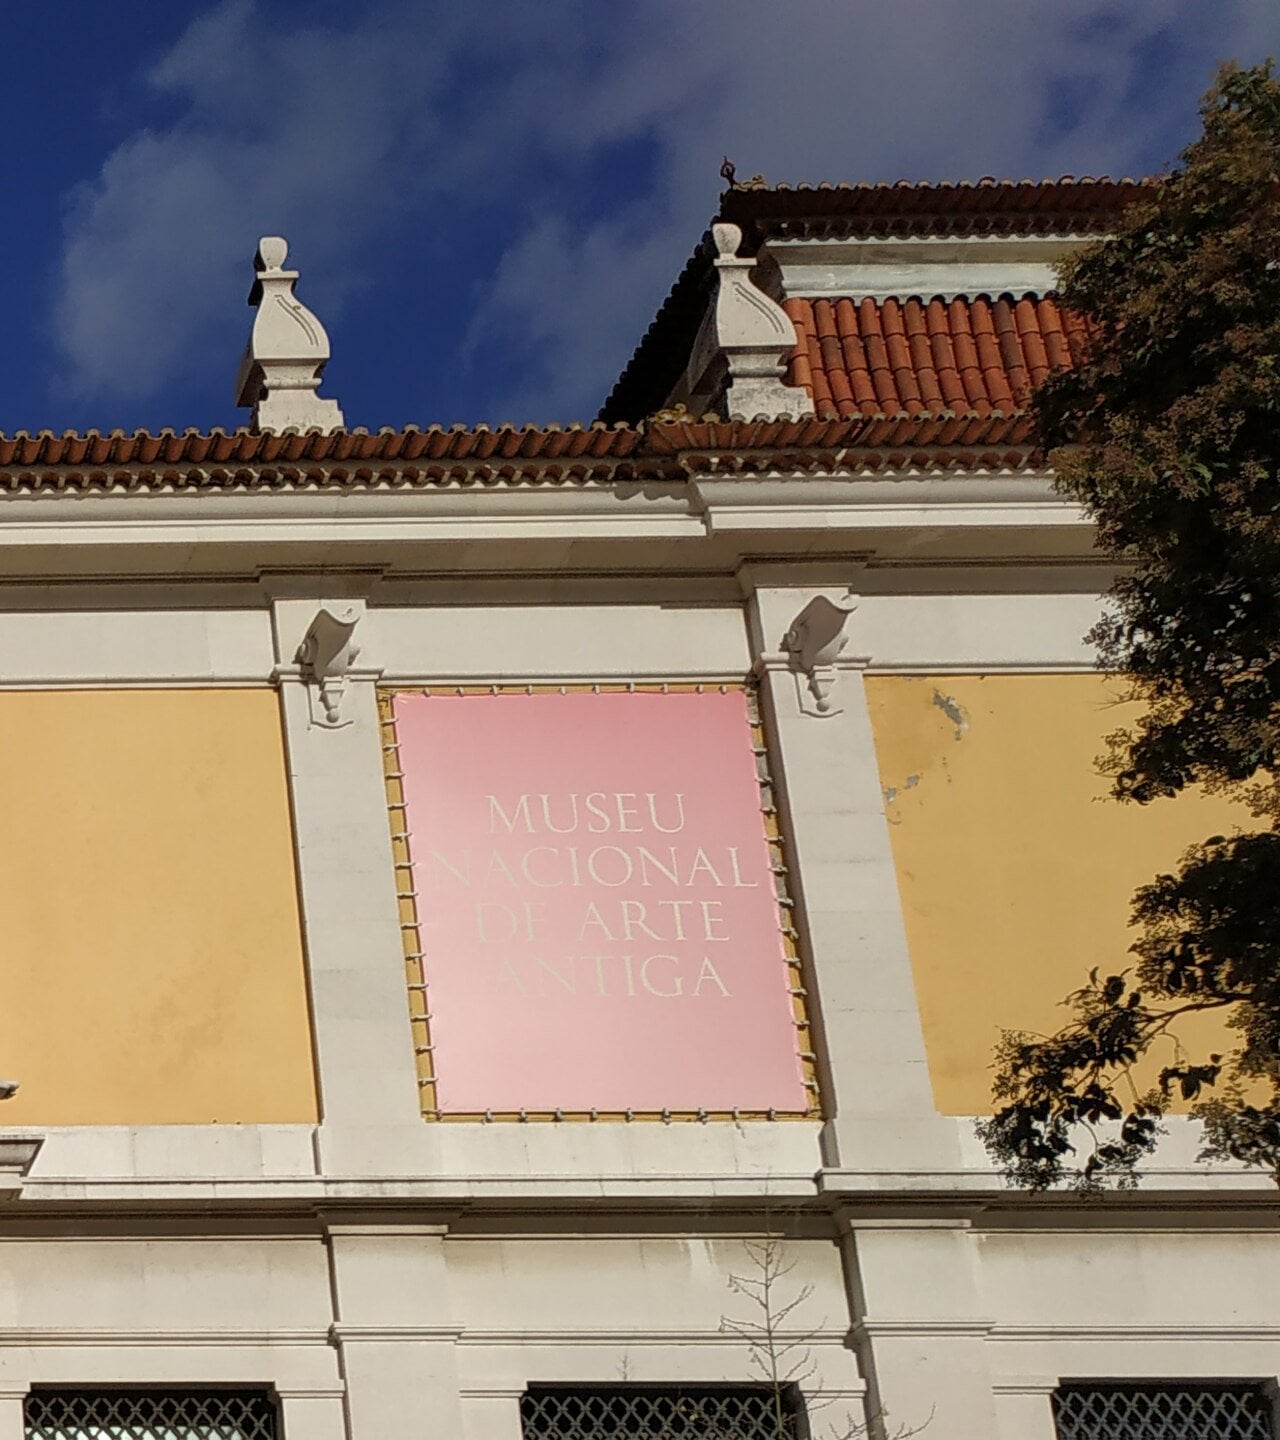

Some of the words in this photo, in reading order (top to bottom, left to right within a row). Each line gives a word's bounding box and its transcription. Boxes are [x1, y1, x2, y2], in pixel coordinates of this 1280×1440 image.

[486, 792, 686, 834] MUSEU
[431, 845, 758, 889] NACIONAL
[475, 901, 552, 944] DE
[577, 900, 730, 942] ARTE
[496, 954, 733, 998] ANTIGA
